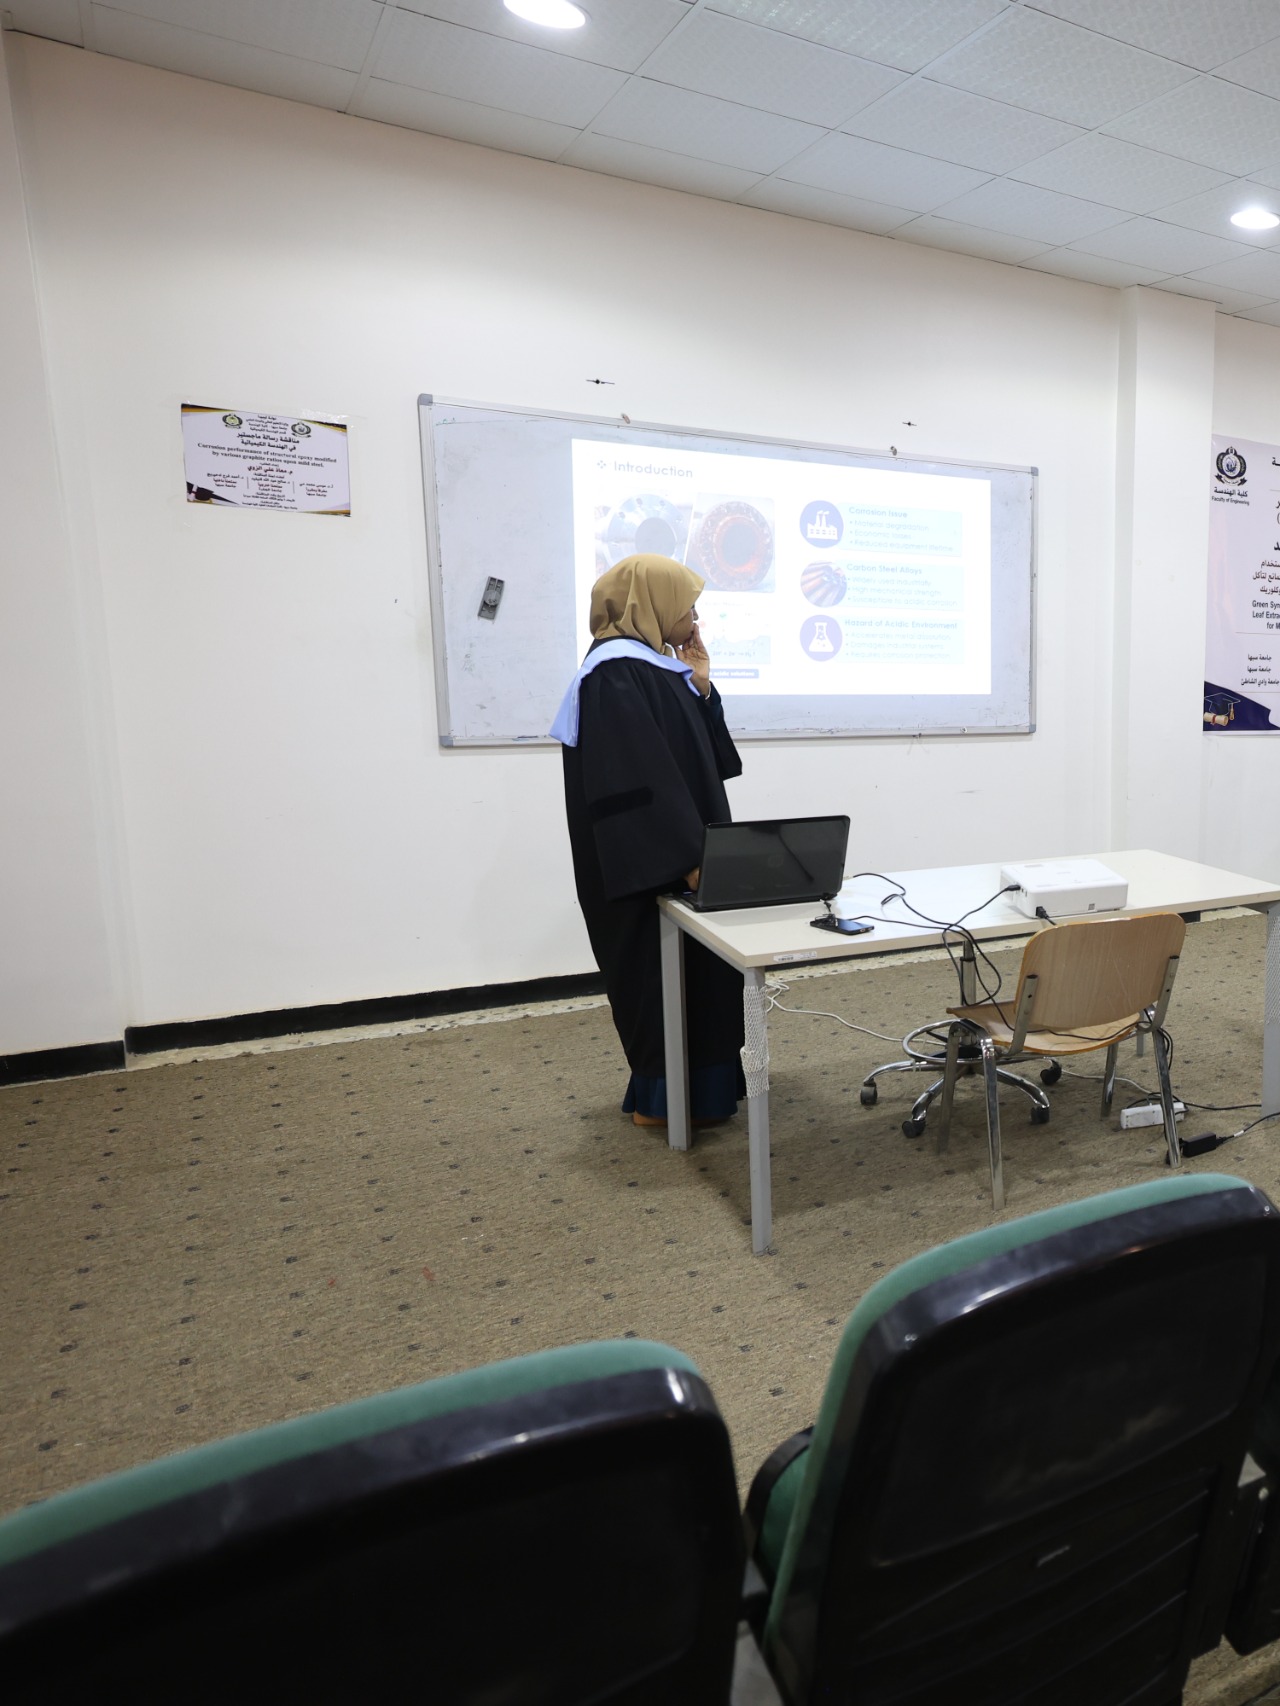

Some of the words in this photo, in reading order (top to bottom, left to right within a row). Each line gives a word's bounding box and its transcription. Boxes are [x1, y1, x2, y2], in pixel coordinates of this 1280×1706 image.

[237, 432, 261, 440] ماجستير
[262, 434, 278, 442] رسالة
[280, 436, 300, 444] مناقشة
[241, 439, 266, 448] الكيميائية
[268, 442, 288, 450] الهندسة
[197, 442, 226, 450] Corrosion
[227, 446, 262, 454] performance
[270, 451, 296, 459] structural
[614, 460, 694, 478] Introduction
[1214, 486, 1236, 497] الهندسة
[1237, 489, 1248, 499] كلية
[1211, 495, 1225, 503] Faculty
[1230, 498, 1250, 506] Engineering
[848, 506, 887, 518] Corrosion
[854, 519, 884, 528] Material
[885, 522, 930, 532] degradation
[854, 529, 890, 538] Economic
[854, 538, 888, 548] Reduced
[889, 541, 927, 551] equipment
[928, 543, 954, 552] lifetime
[846, 563, 877, 572] Carbon
[878, 565, 898, 573] Steel
[899, 566, 922, 575] Alloys
[852, 576, 876, 585] Widely
[878, 577, 894, 585] used
[852, 586, 868, 594] High
[913, 589, 942, 598] strength
[904, 598, 925, 606] acidic
[1252, 600, 1268, 609] Green
[845, 618, 873, 627] Hazard
[885, 620, 909, 628] Acidic
[911, 621, 958, 630] Environment
[1266, 622, 1274, 630] for
[850, 642, 885, 650] Damages
[1248, 653, 1258, 662] سبها
[1259, 654, 1272, 662] جامعة
[1247, 665, 1258, 673] سبها
[1268, 678, 1280, 686] جامعة
